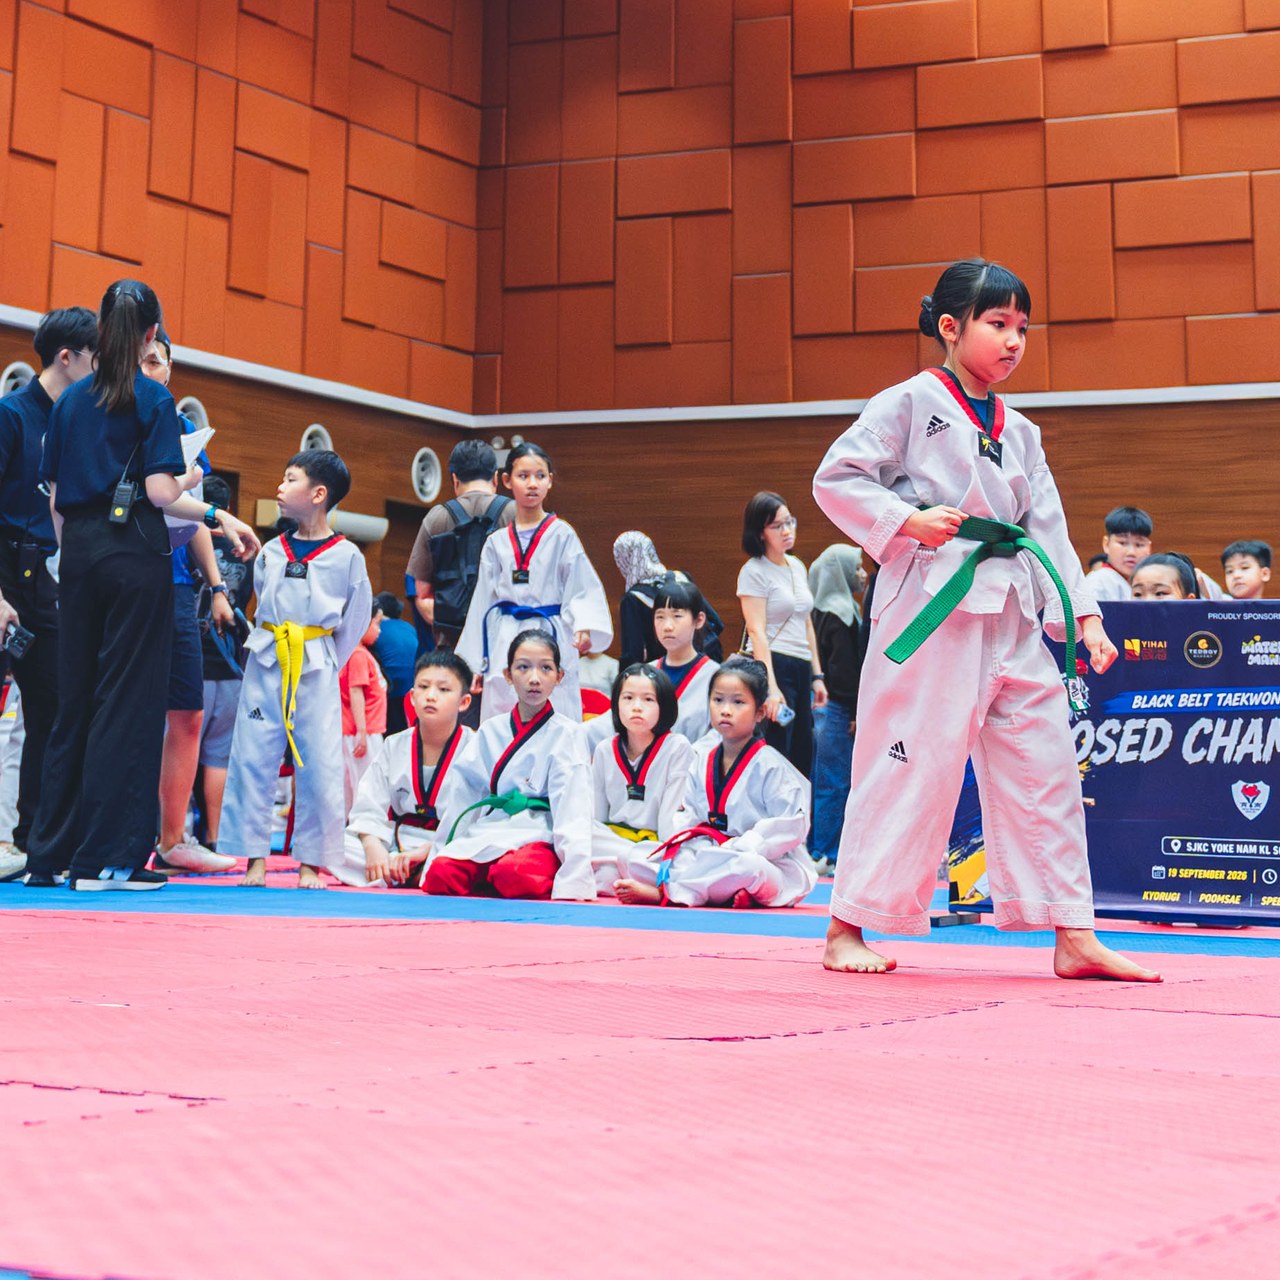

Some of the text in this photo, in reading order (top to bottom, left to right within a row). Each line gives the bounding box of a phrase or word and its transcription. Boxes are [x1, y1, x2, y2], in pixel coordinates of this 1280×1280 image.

[926, 422, 951, 438] adidas
[1207, 612, 1241, 620] PROUDLY
[1141, 640, 1168, 649] YIHAI
[1131, 694, 1172, 709] BLACK
[1178, 692, 1212, 707] BELT
[1071, 717, 1173, 766] OSED
[1186, 841, 1209, 853] SJKC
[1211, 842, 1234, 854] YOKE
[1236, 843, 1257, 855] NAM
[1259, 845, 1271, 856] KL
[1168, 867, 1248, 881] 19 SEPTEMBER 2026
[1142, 890, 1181, 902] KYORUGI
[1199, 892, 1241, 905] POOMSAE
